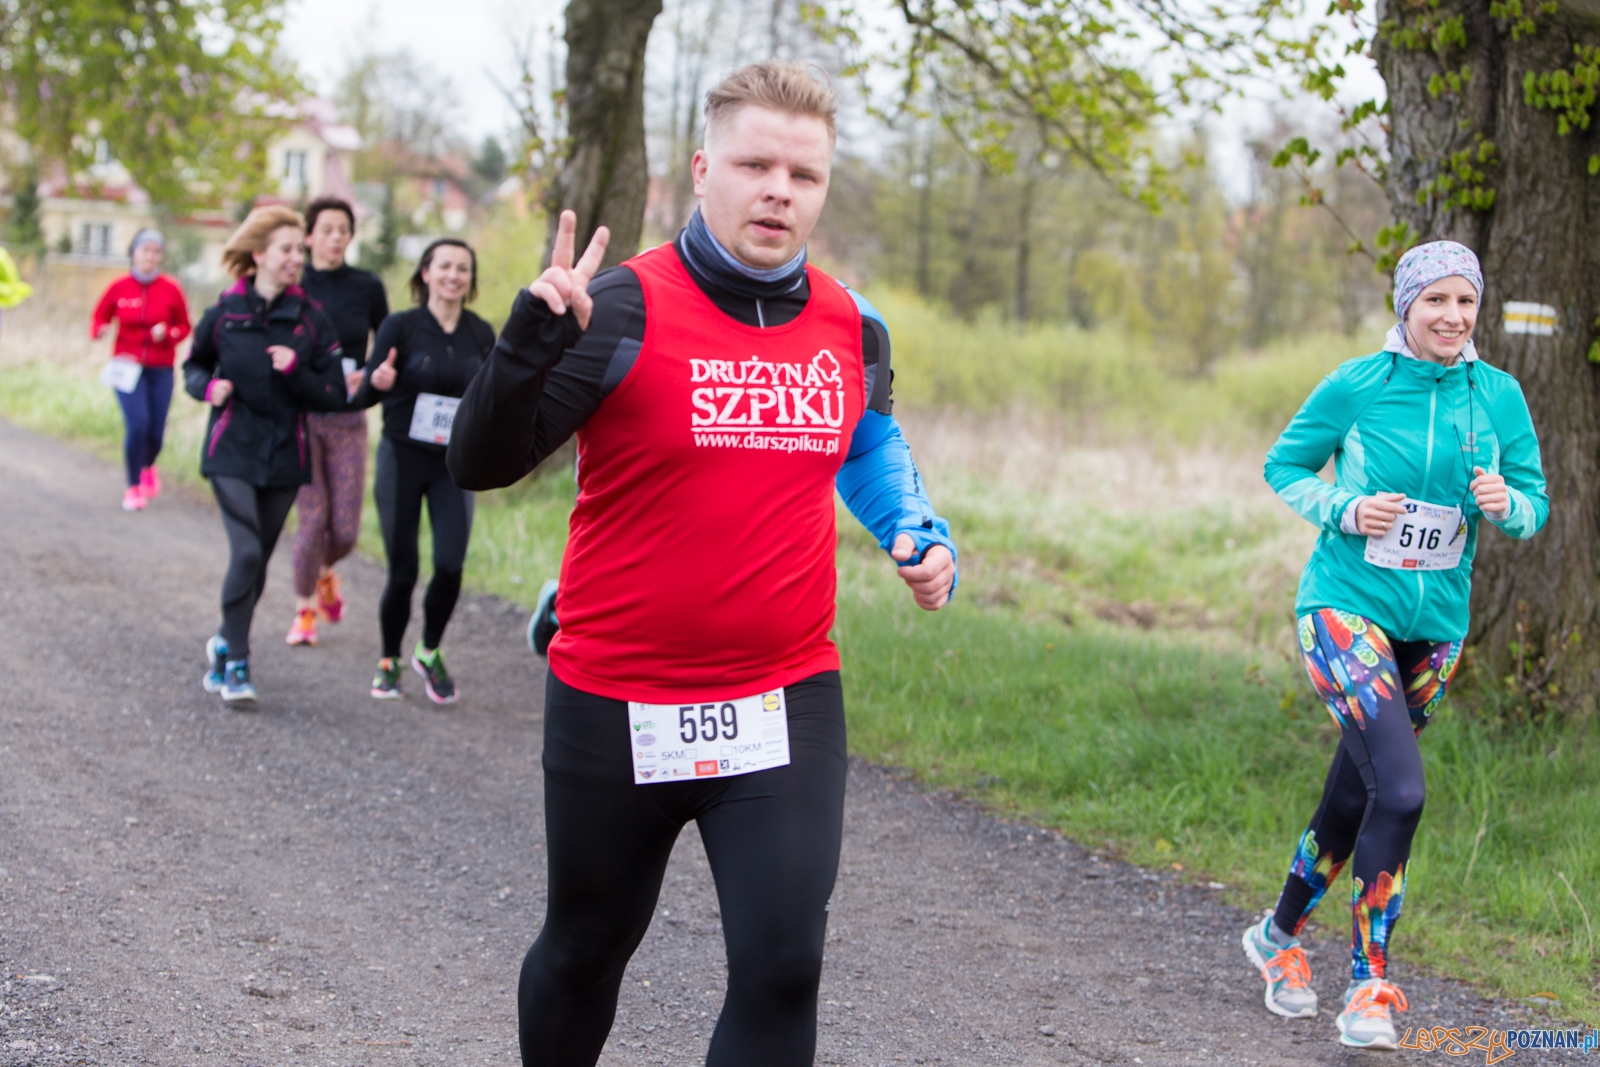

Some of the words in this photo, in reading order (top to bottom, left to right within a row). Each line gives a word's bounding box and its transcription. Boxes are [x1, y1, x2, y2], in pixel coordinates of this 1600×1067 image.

[689, 355, 824, 387] DRUŻYNA
[691, 386, 845, 428] SZPIKU
[694, 432, 840, 456] www.darszpiku.pl
[1399, 523, 1442, 550] 516
[679, 703, 738, 744] 559
[661, 750, 685, 761] 5KM
[733, 743, 762, 754] 10KM
